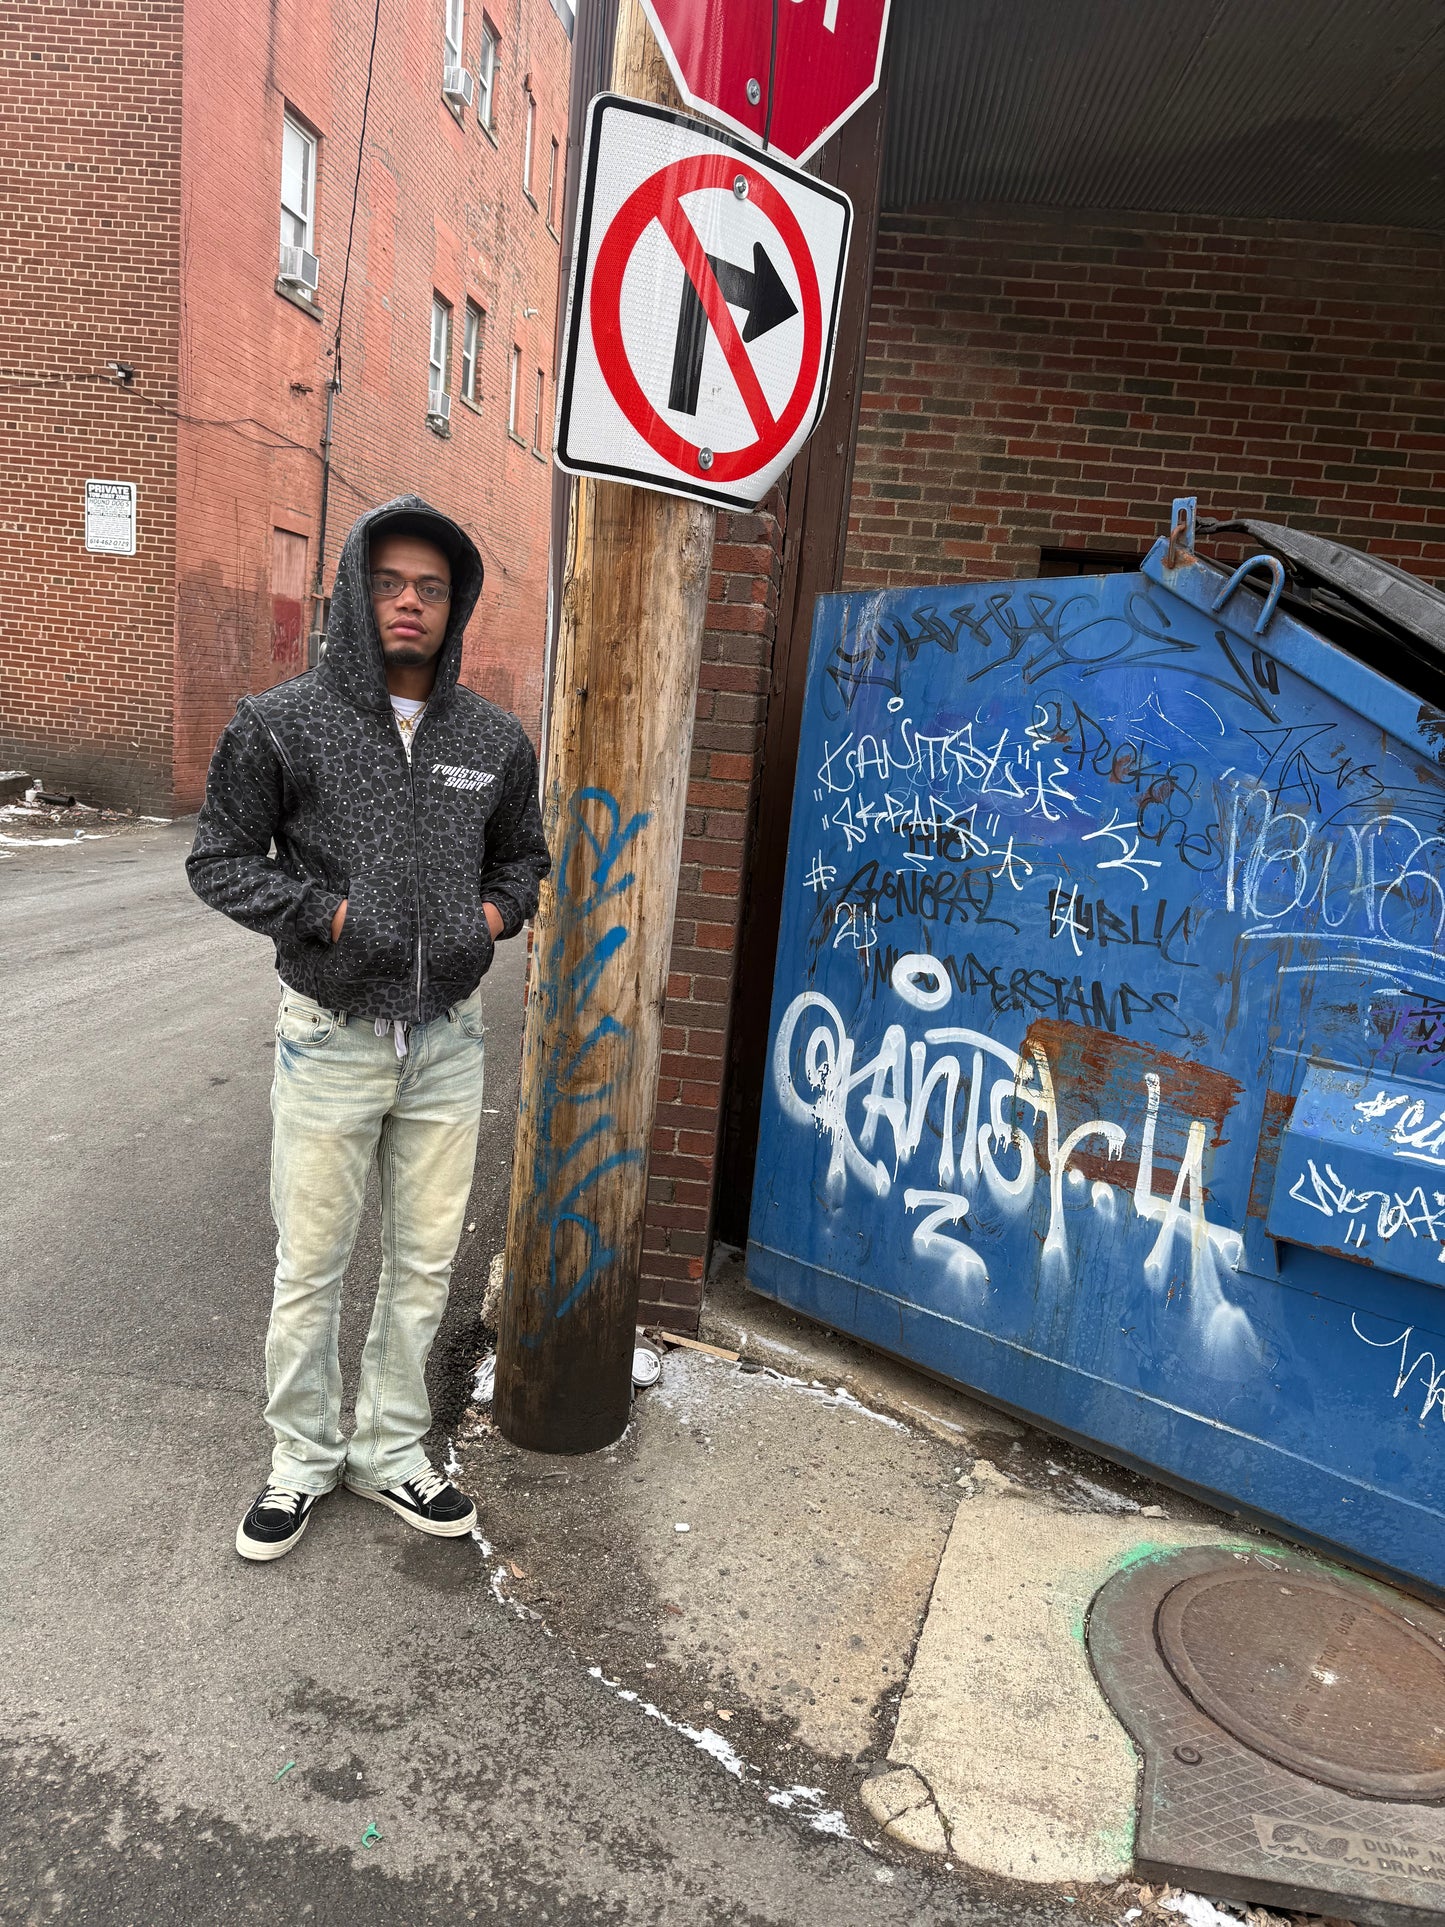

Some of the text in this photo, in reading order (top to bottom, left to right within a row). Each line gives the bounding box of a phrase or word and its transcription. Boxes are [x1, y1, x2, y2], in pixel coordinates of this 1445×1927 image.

[88, 483, 130, 495] PRIVATE
[89, 498, 110, 506] HOUND
[431, 763, 496, 784] TWISTED
[443, 776, 487, 792] SIGHT
[1362, 1838, 1445, 1864] DUMP N
